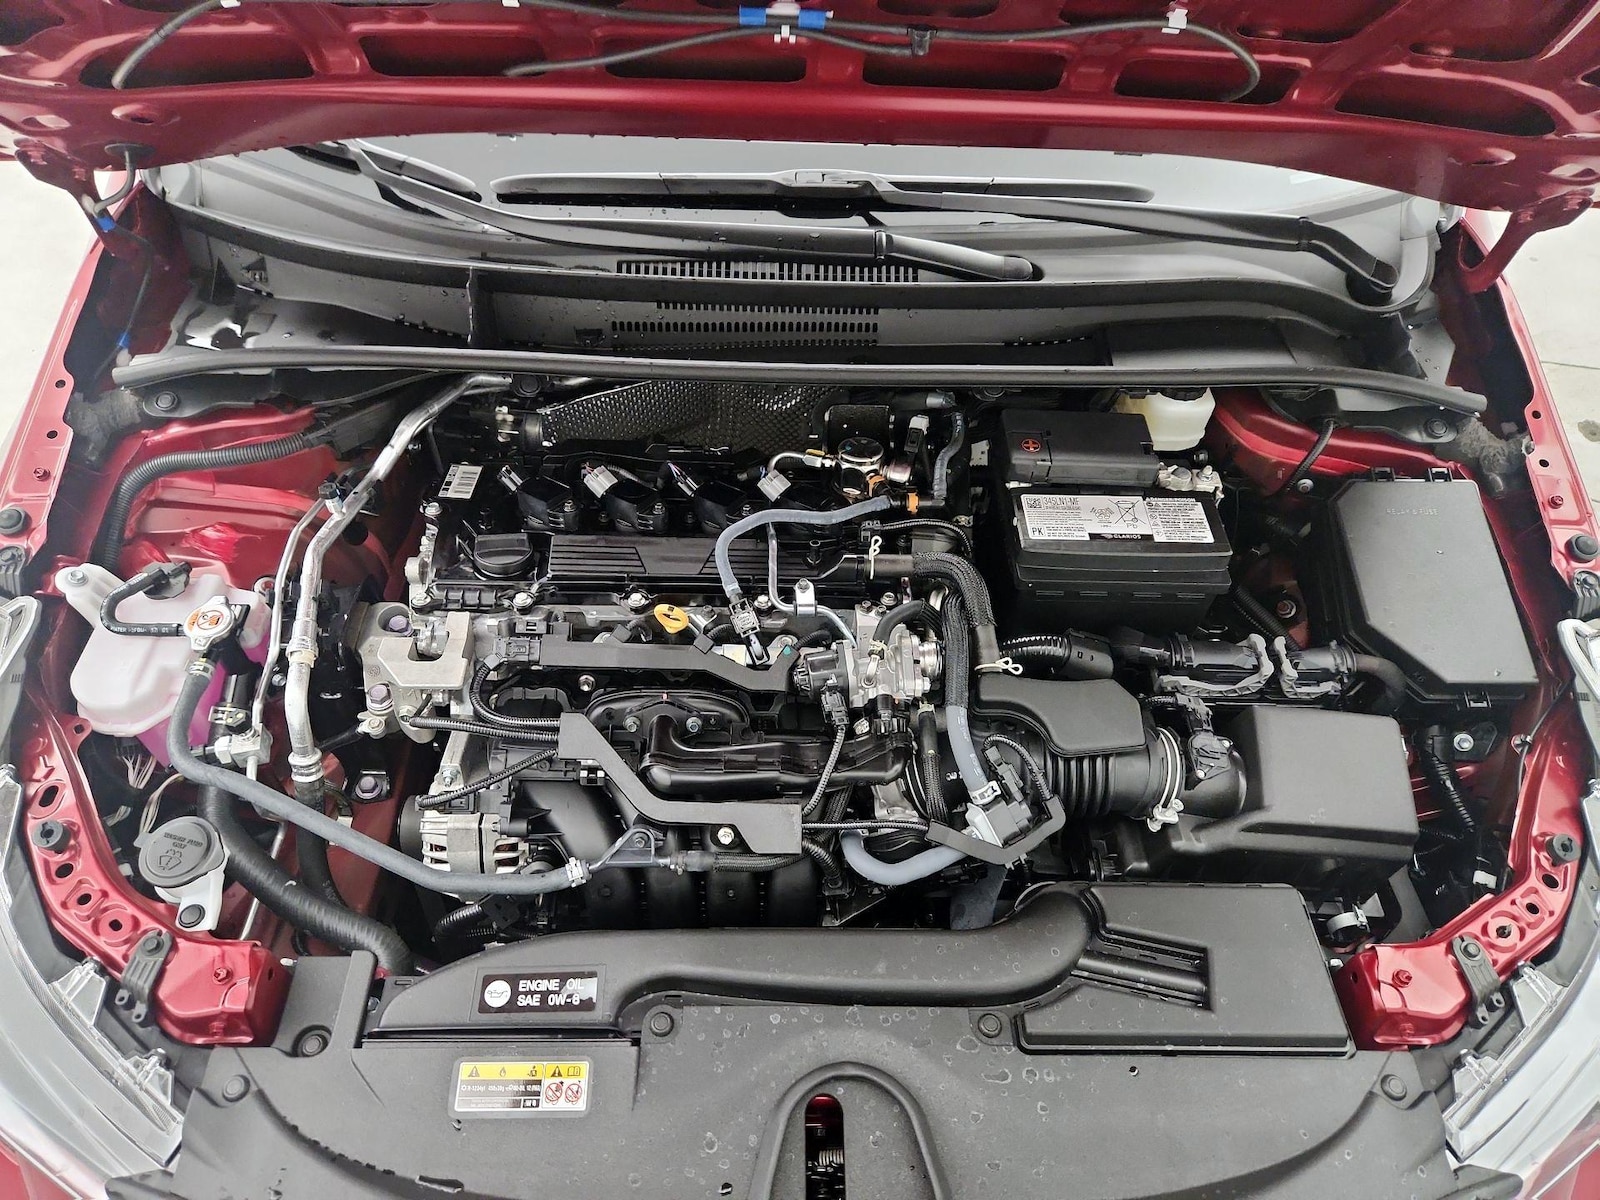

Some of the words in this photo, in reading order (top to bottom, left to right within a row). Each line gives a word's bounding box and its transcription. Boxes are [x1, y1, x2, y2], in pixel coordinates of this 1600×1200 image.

[1032, 527, 1044, 536] PK
[518, 979, 560, 991] ENGINE
[566, 978, 585, 990] OIL
[517, 994, 542, 1006] SAE
[547, 994, 581, 1006] 0W-8
